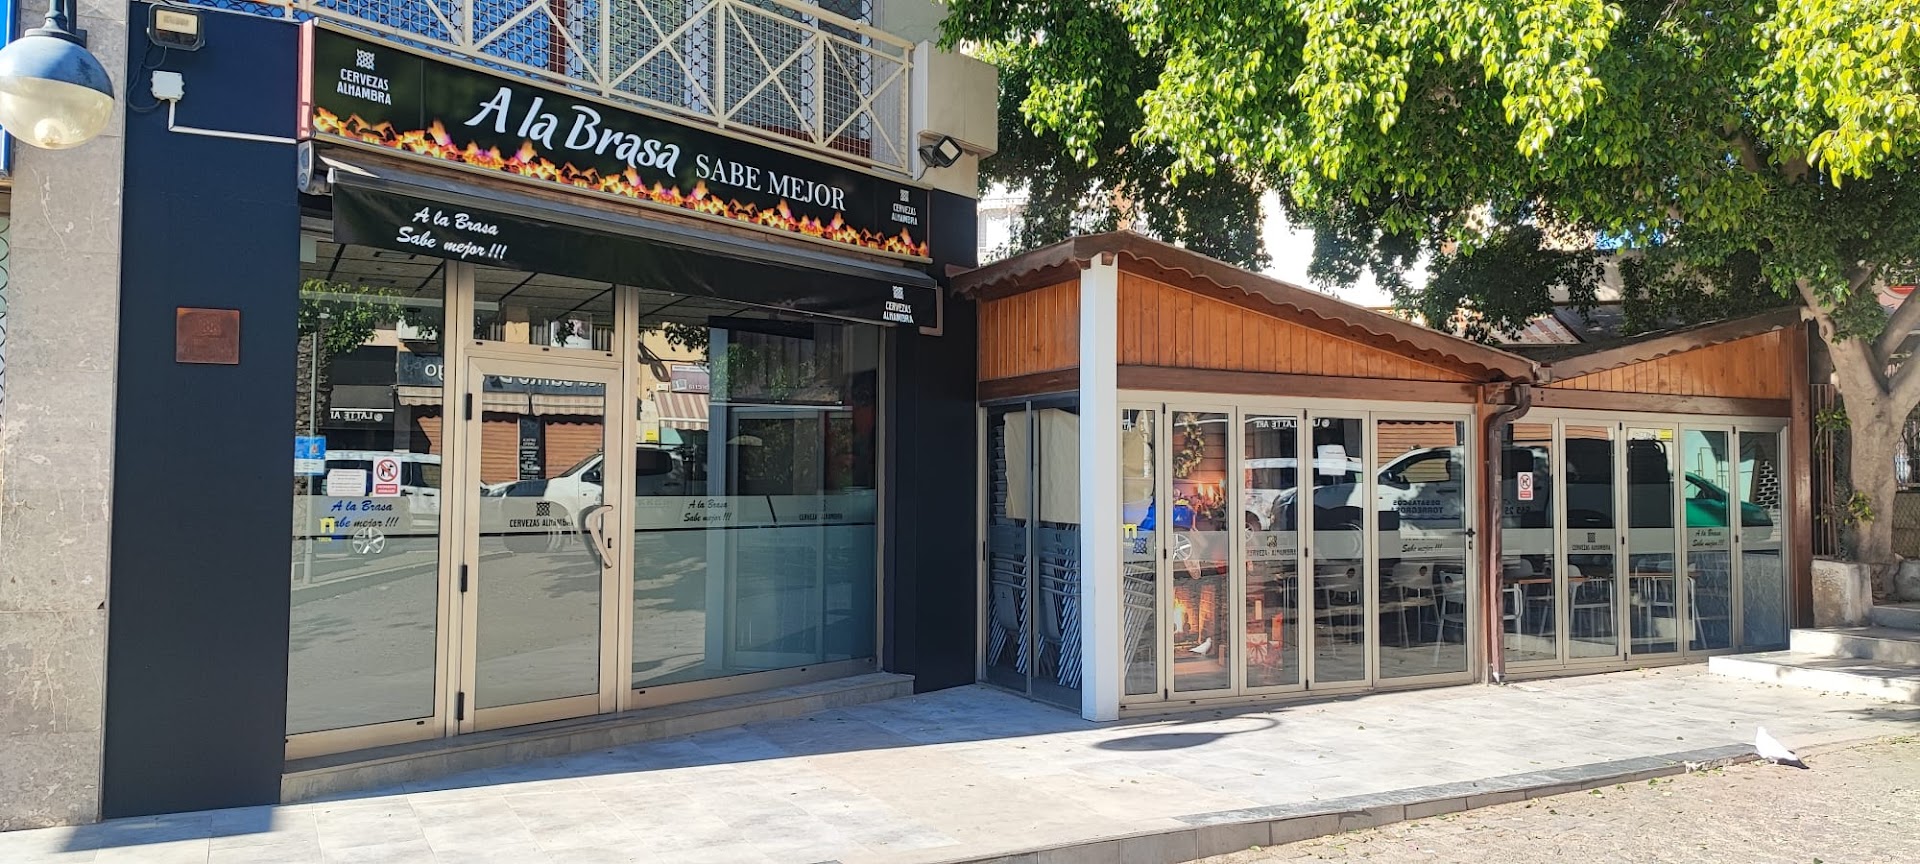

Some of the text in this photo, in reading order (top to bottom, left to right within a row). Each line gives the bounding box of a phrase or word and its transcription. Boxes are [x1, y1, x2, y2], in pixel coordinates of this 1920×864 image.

[340, 68, 389, 91] CERVEZAS
[336, 81, 392, 106] ALHAMBRA
[463, 87, 847, 211] A la Brasa SABE MEJOR
[892, 203, 917, 216] CERVEZAS
[412, 207, 499, 235] A la Brasa
[891, 213, 918, 226] ALHAMBRA
[396, 226, 437, 248] Sabe
[443, 241, 486, 259] mejor
[885, 301, 912, 314] CERVEZAS
[883, 311, 914, 324] ALHAMBRA
[331, 500, 393, 512] A la Brasa
[353, 518, 383, 530] mejor
[509, 518, 574, 528] CERVEZAS ALHAMB
